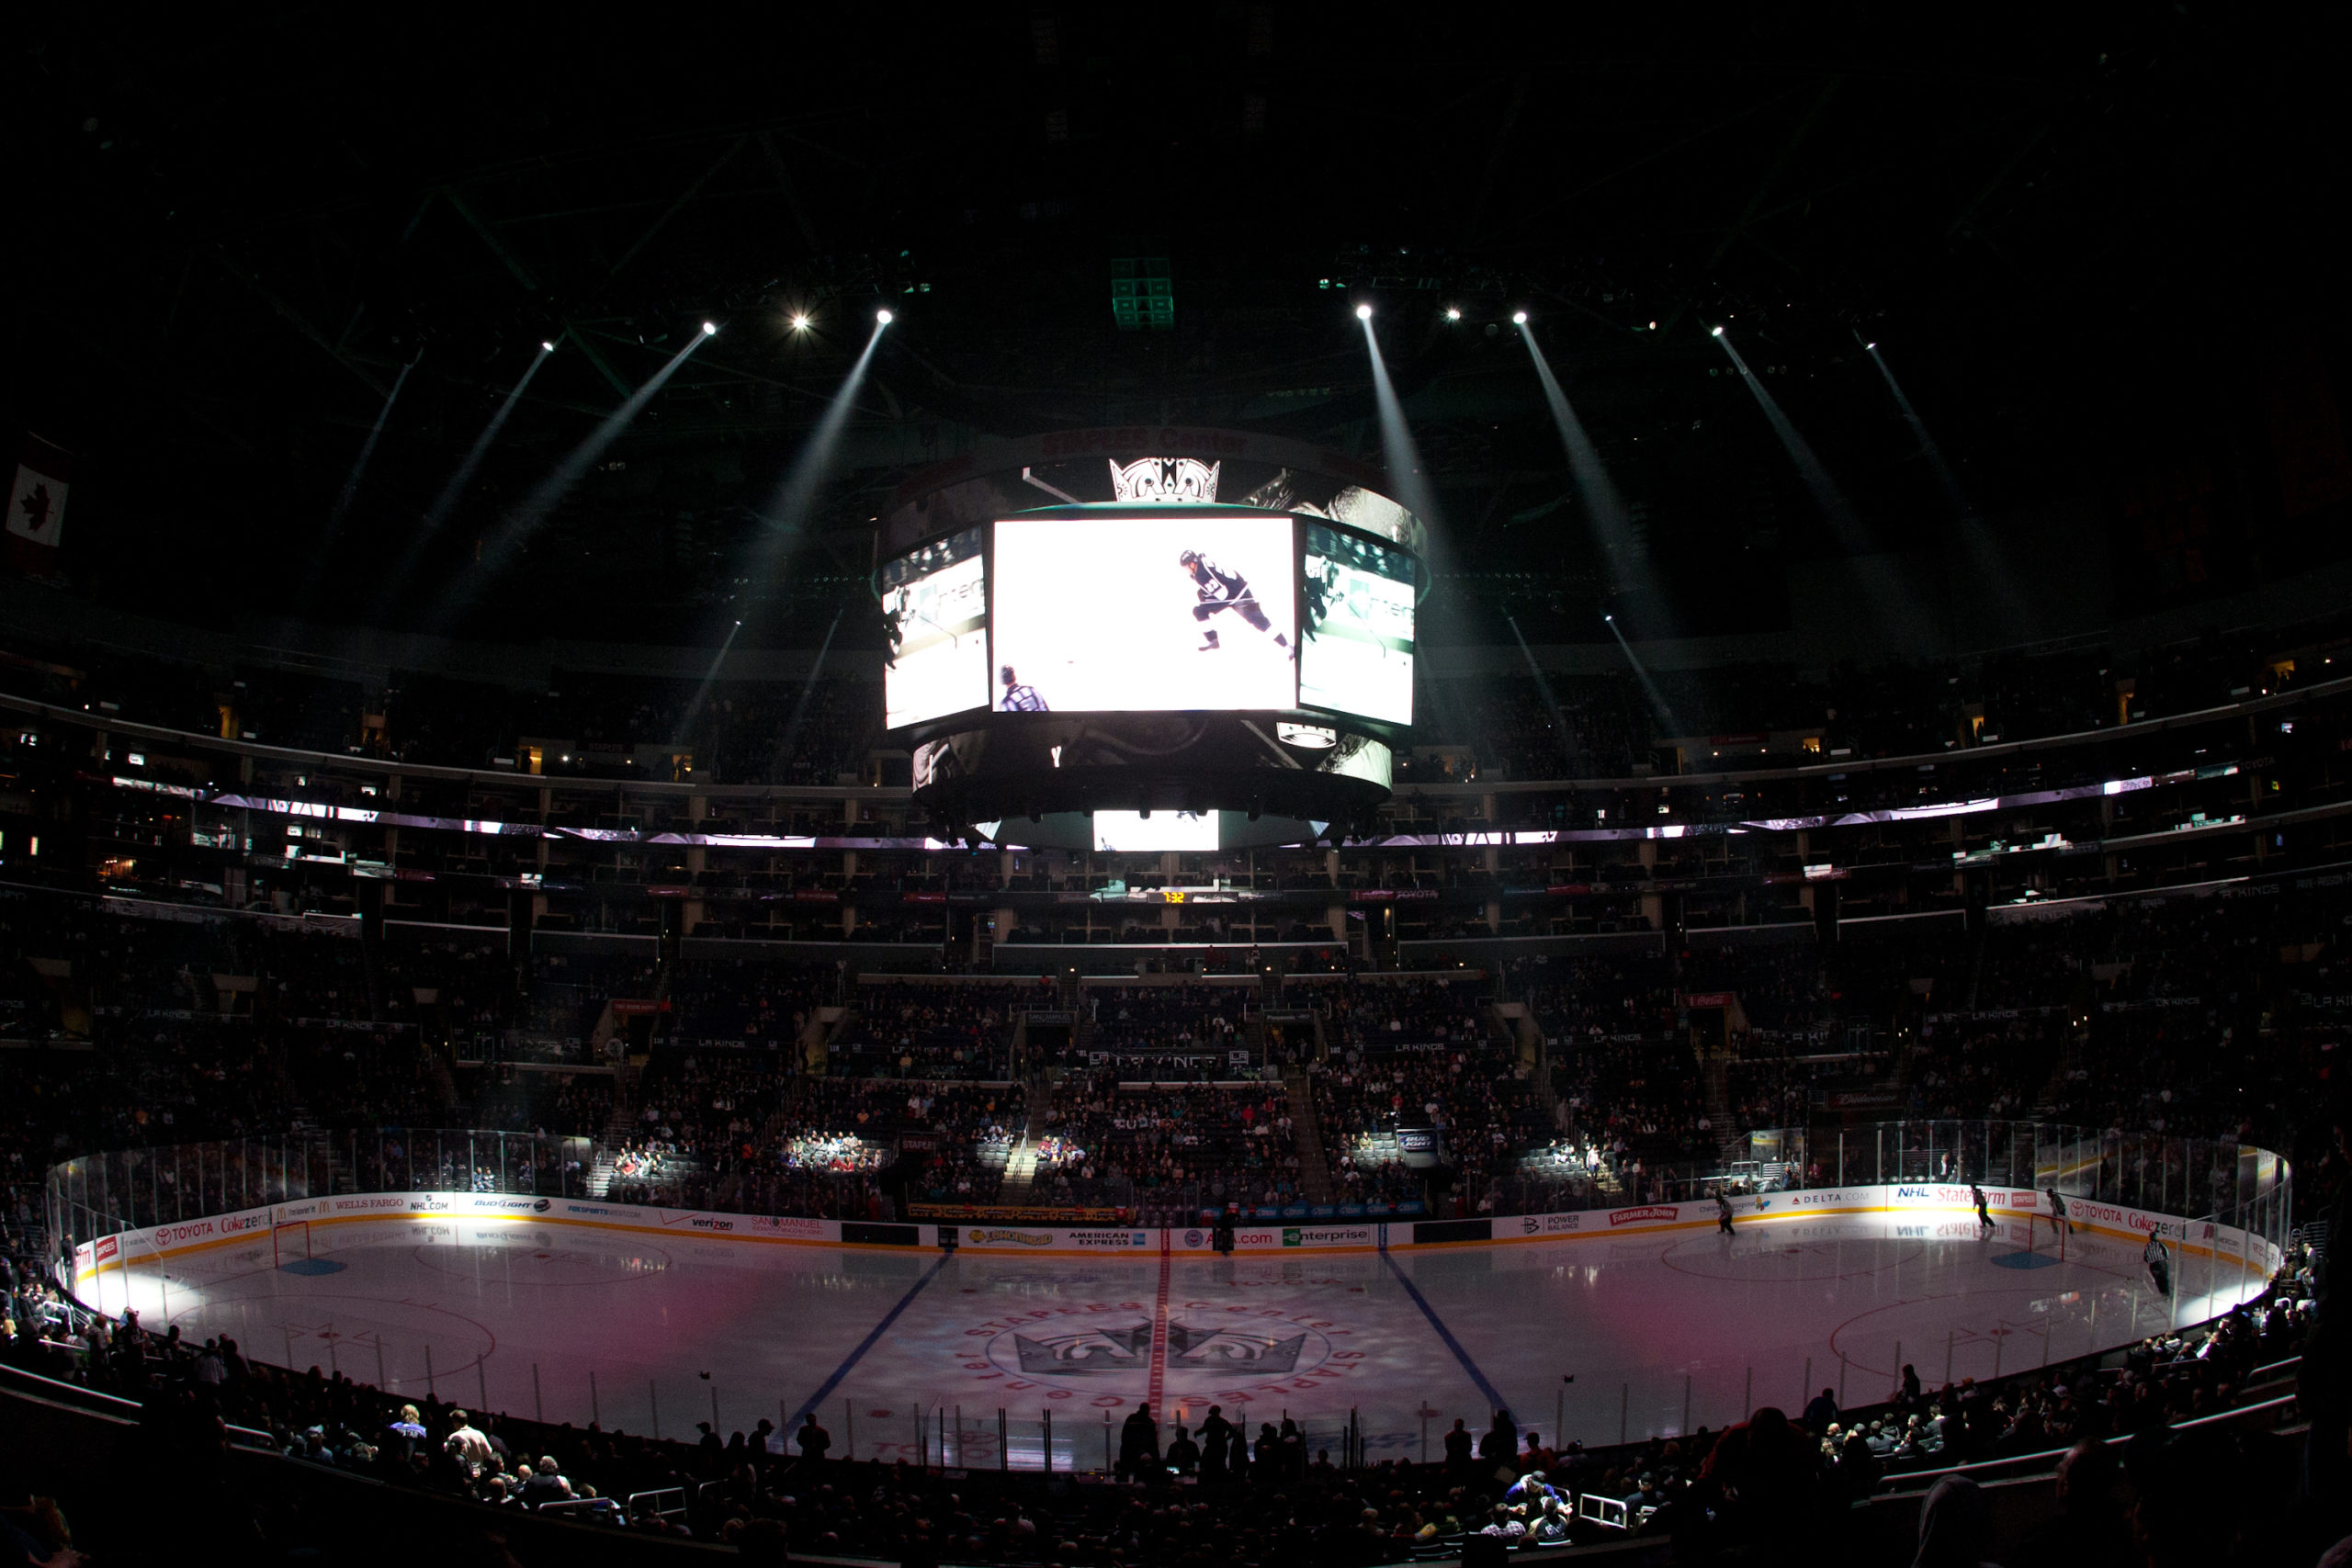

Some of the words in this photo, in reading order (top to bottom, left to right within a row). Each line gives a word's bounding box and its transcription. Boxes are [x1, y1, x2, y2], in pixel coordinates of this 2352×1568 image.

[1897, 1187, 1929, 1198] NHL
[336, 1200, 367, 1211] WELLS
[368, 1198, 404, 1208] FARGO
[410, 1201, 448, 1211] NHL.COM
[1547, 1215, 1579, 1224] POWER
[1611, 1209, 1650, 1223] FARMER
[1651, 1206, 1677, 1218] JOHN
[2085, 1204, 2122, 1224] TOYOTA
[692, 1218, 734, 1231] verizon
[752, 1216, 772, 1225] SAN
[780, 1218, 822, 1229] MANUEL
[1547, 1223, 1578, 1231] BALANCE
[172, 1223, 214, 1240] TOYOTA
[965, 1301, 1141, 1337] STAPLES
[1184, 1301, 1352, 1337] Center
